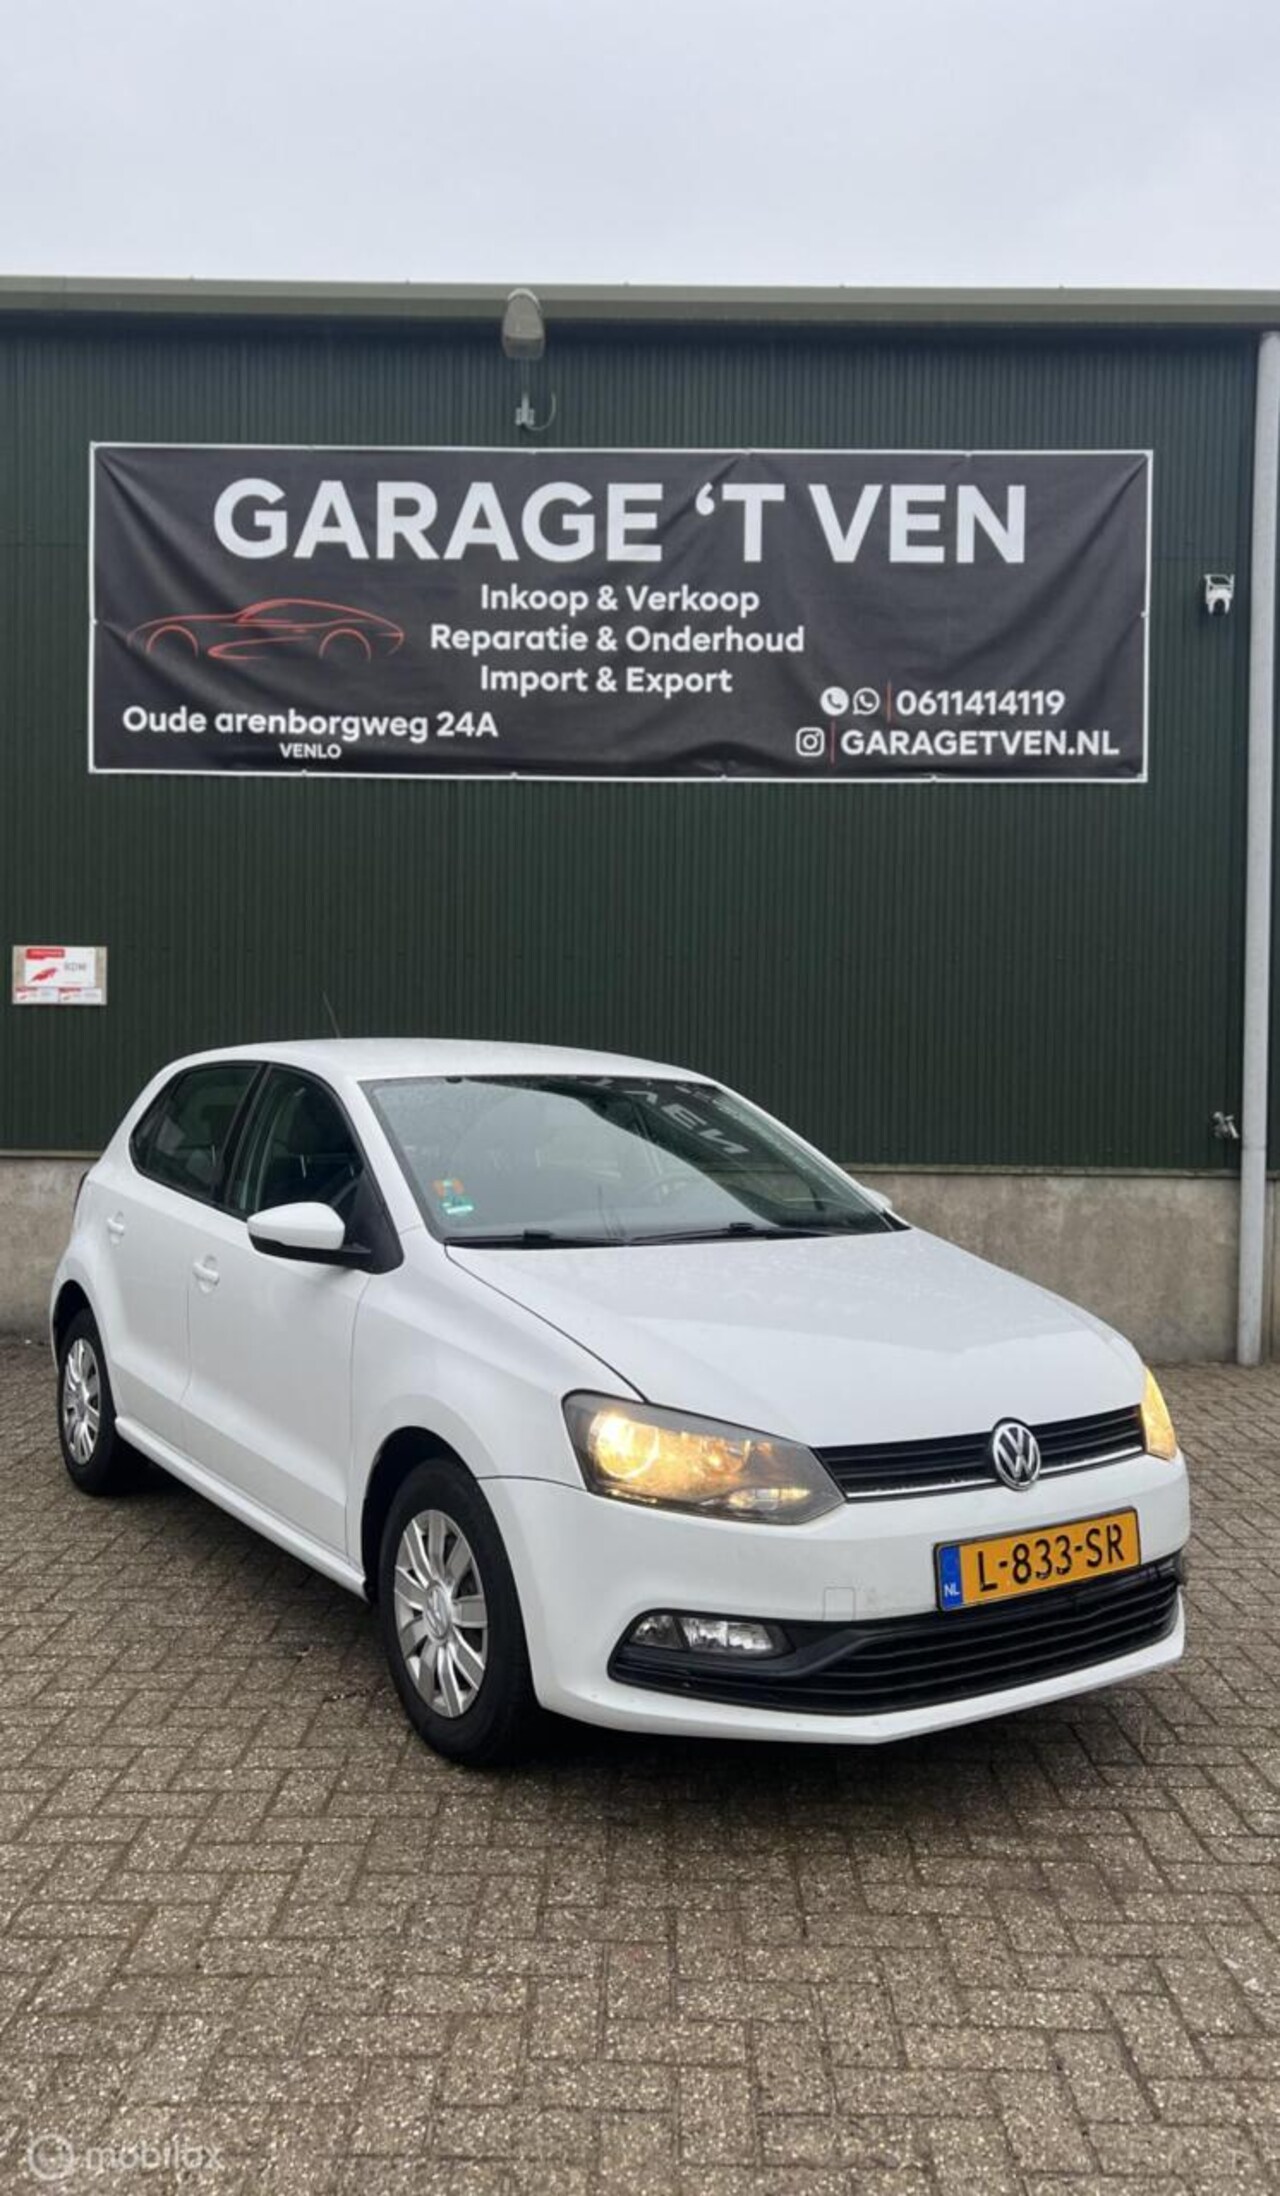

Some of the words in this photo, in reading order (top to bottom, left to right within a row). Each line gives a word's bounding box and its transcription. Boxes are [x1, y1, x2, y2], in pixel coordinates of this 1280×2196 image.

[213, 478, 663, 563] GARAGE
[808, 483, 1026, 564] VEN
[481, 583, 589, 616] Inkoop
[596, 585, 618, 611] &
[625, 584, 760, 619] Verkoop
[430, 623, 589, 657] Reparatie
[596, 625, 618, 652] &
[625, 625, 805, 653] Onderhoud
[481, 665, 588, 698] Import
[596, 666, 618, 693] &
[626, 667, 733, 699] Export
[896, 690, 1066, 717] 0611414119
[122, 705, 207, 733] Oude
[214, 708, 429, 744] arenborgweg
[436, 711, 499, 738] 24A
[279, 742, 342, 759] VENLO
[840, 729, 1120, 757] GARAGETVEN.NL
[977, 1523, 1125, 1593] L-833-SR
[943, 1581, 961, 1598] NL
